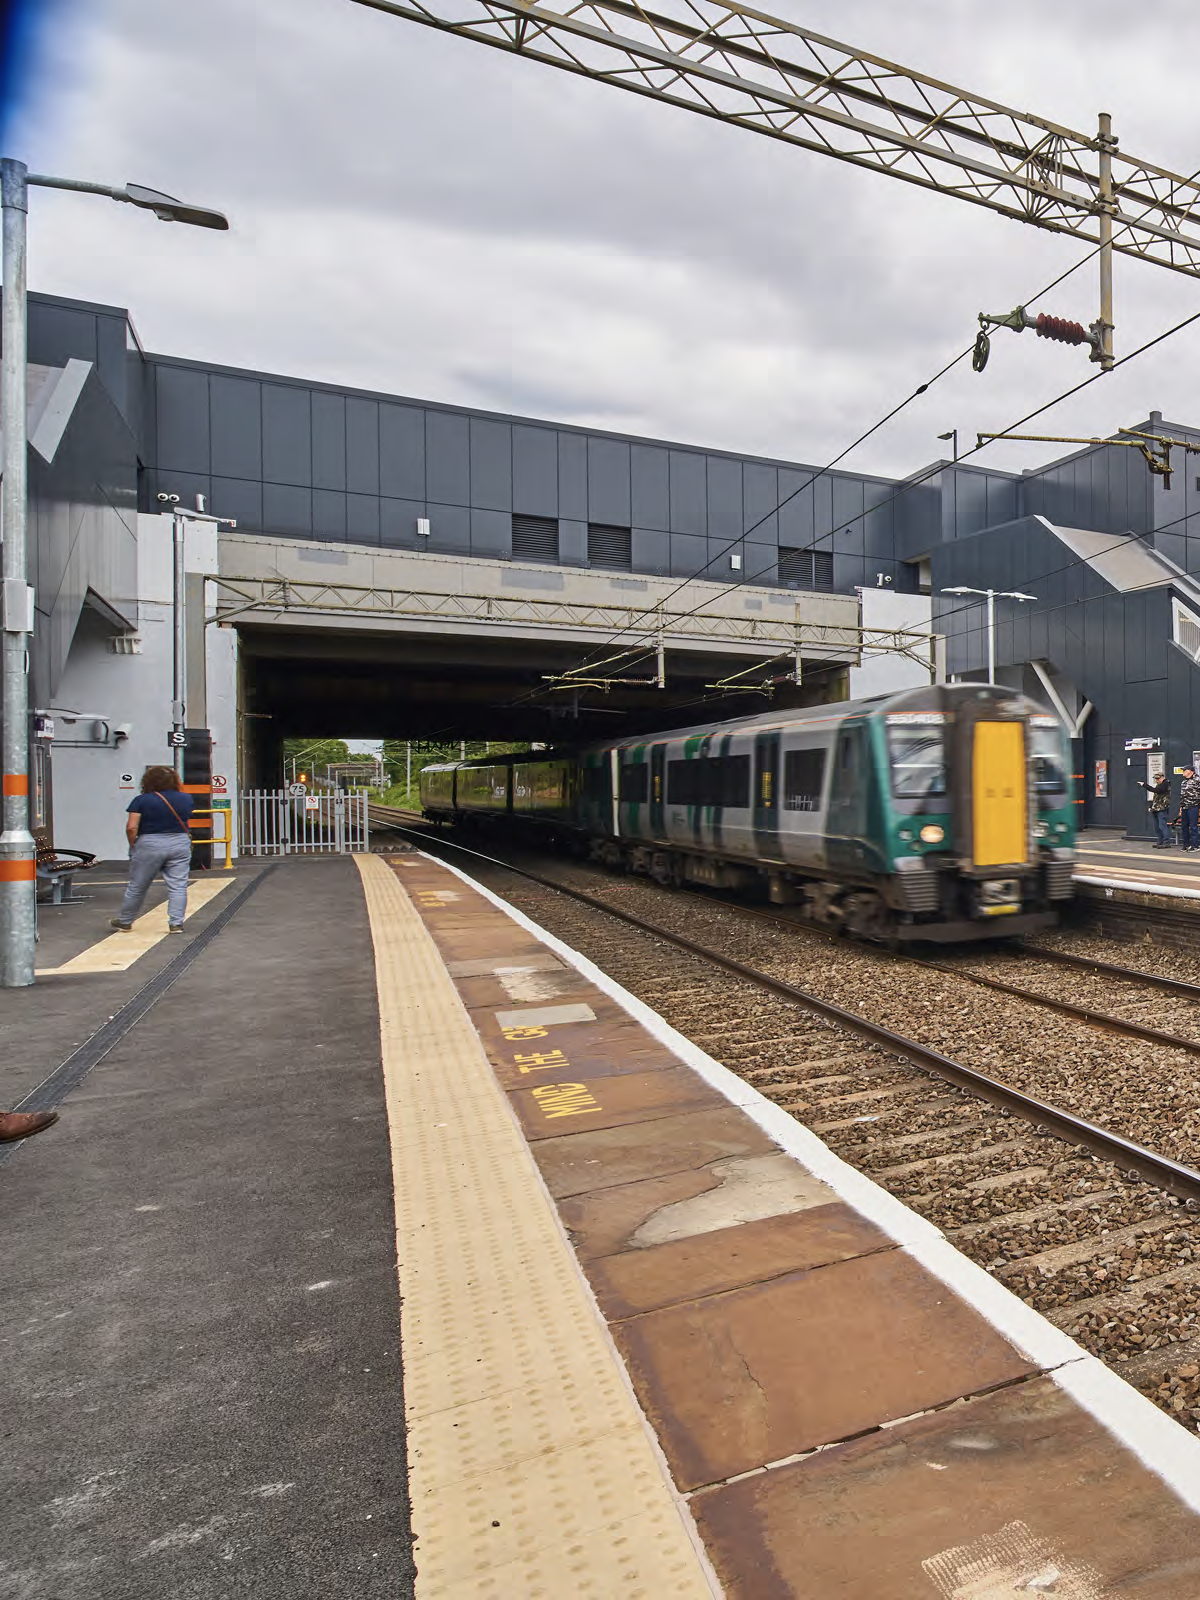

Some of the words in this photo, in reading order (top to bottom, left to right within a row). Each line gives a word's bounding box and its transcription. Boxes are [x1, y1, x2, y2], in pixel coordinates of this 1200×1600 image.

[172, 732, 186, 743] S
[292, 785, 304, 793] 75
[513, 1049, 571, 1074] THE
[531, 1082, 603, 1119] MIND
